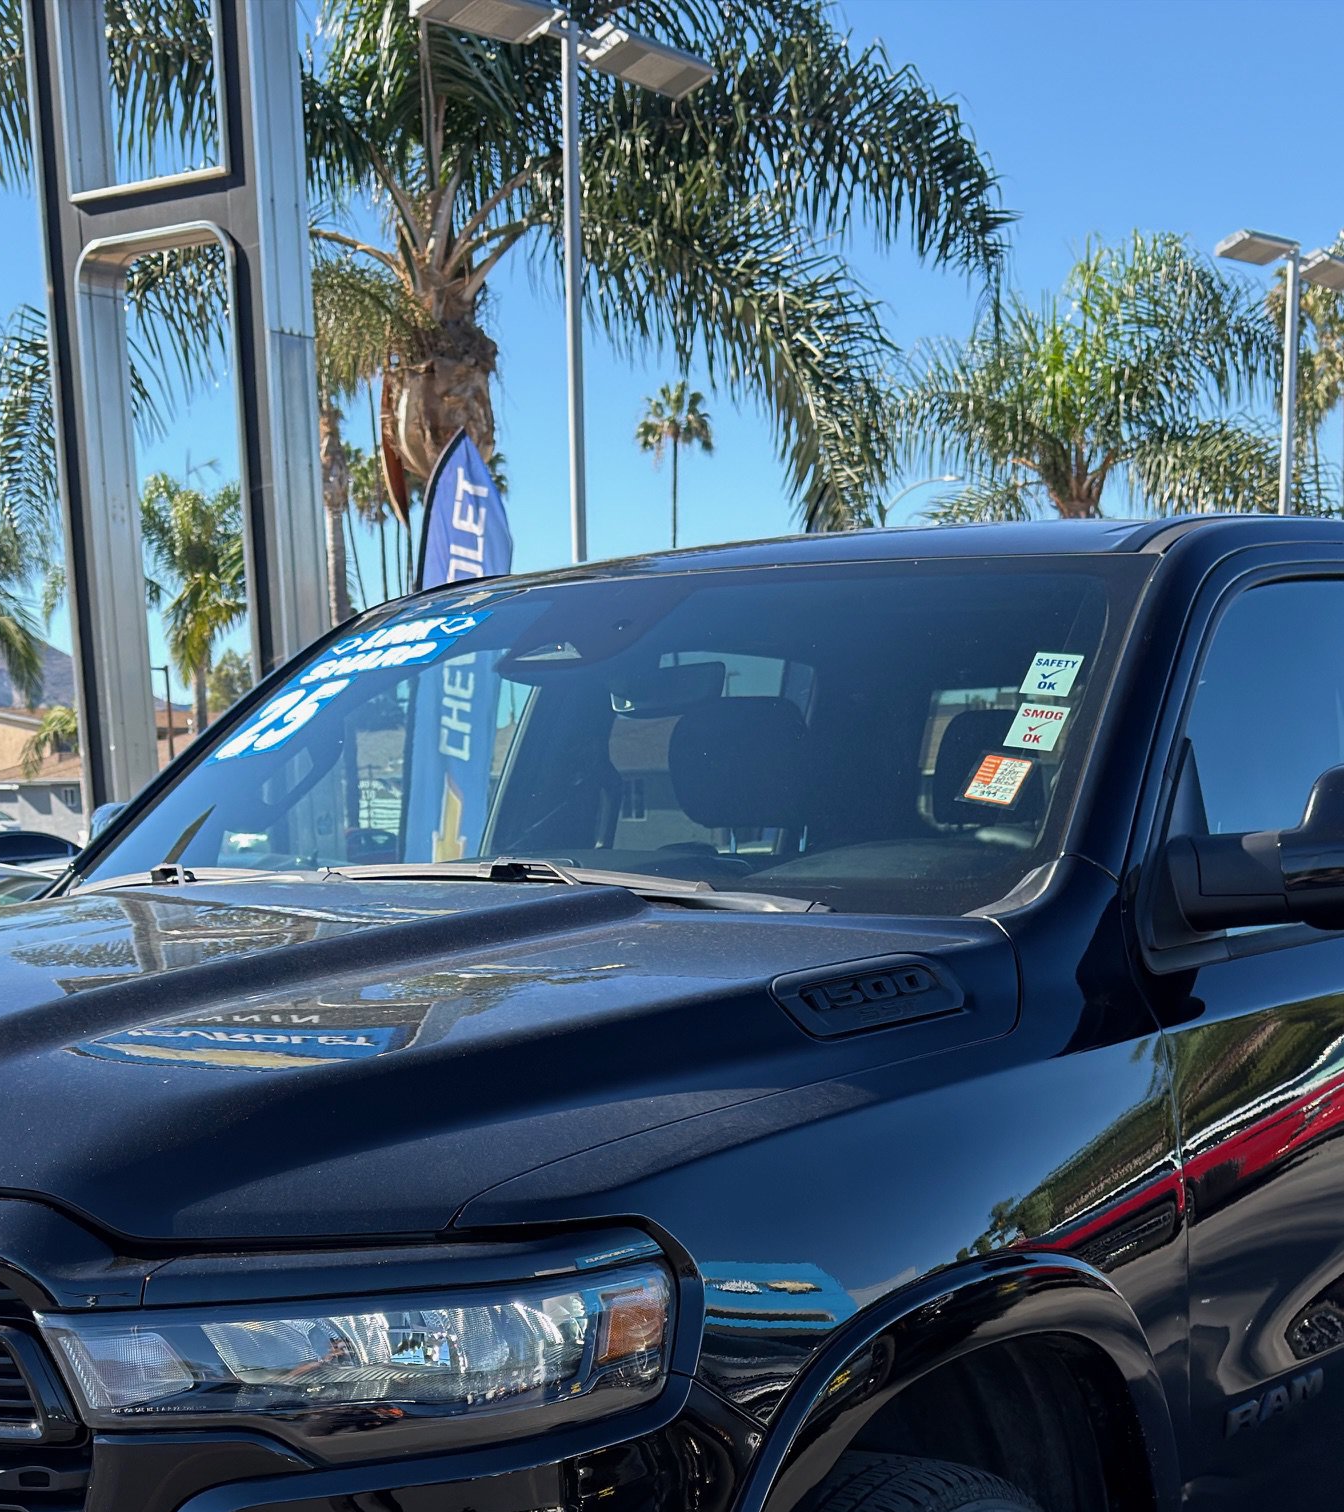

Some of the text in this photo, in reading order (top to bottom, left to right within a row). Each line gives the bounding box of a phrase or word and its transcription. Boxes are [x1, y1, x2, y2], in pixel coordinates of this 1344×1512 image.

[1035, 657, 1079, 669] SAFETY
[1037, 681, 1058, 691] OK
[1022, 707, 1064, 721] SMOG
[1022, 733, 1043, 744] OK
[801, 971, 931, 1011] 1500
[1225, 1367, 1324, 1438] RAM
